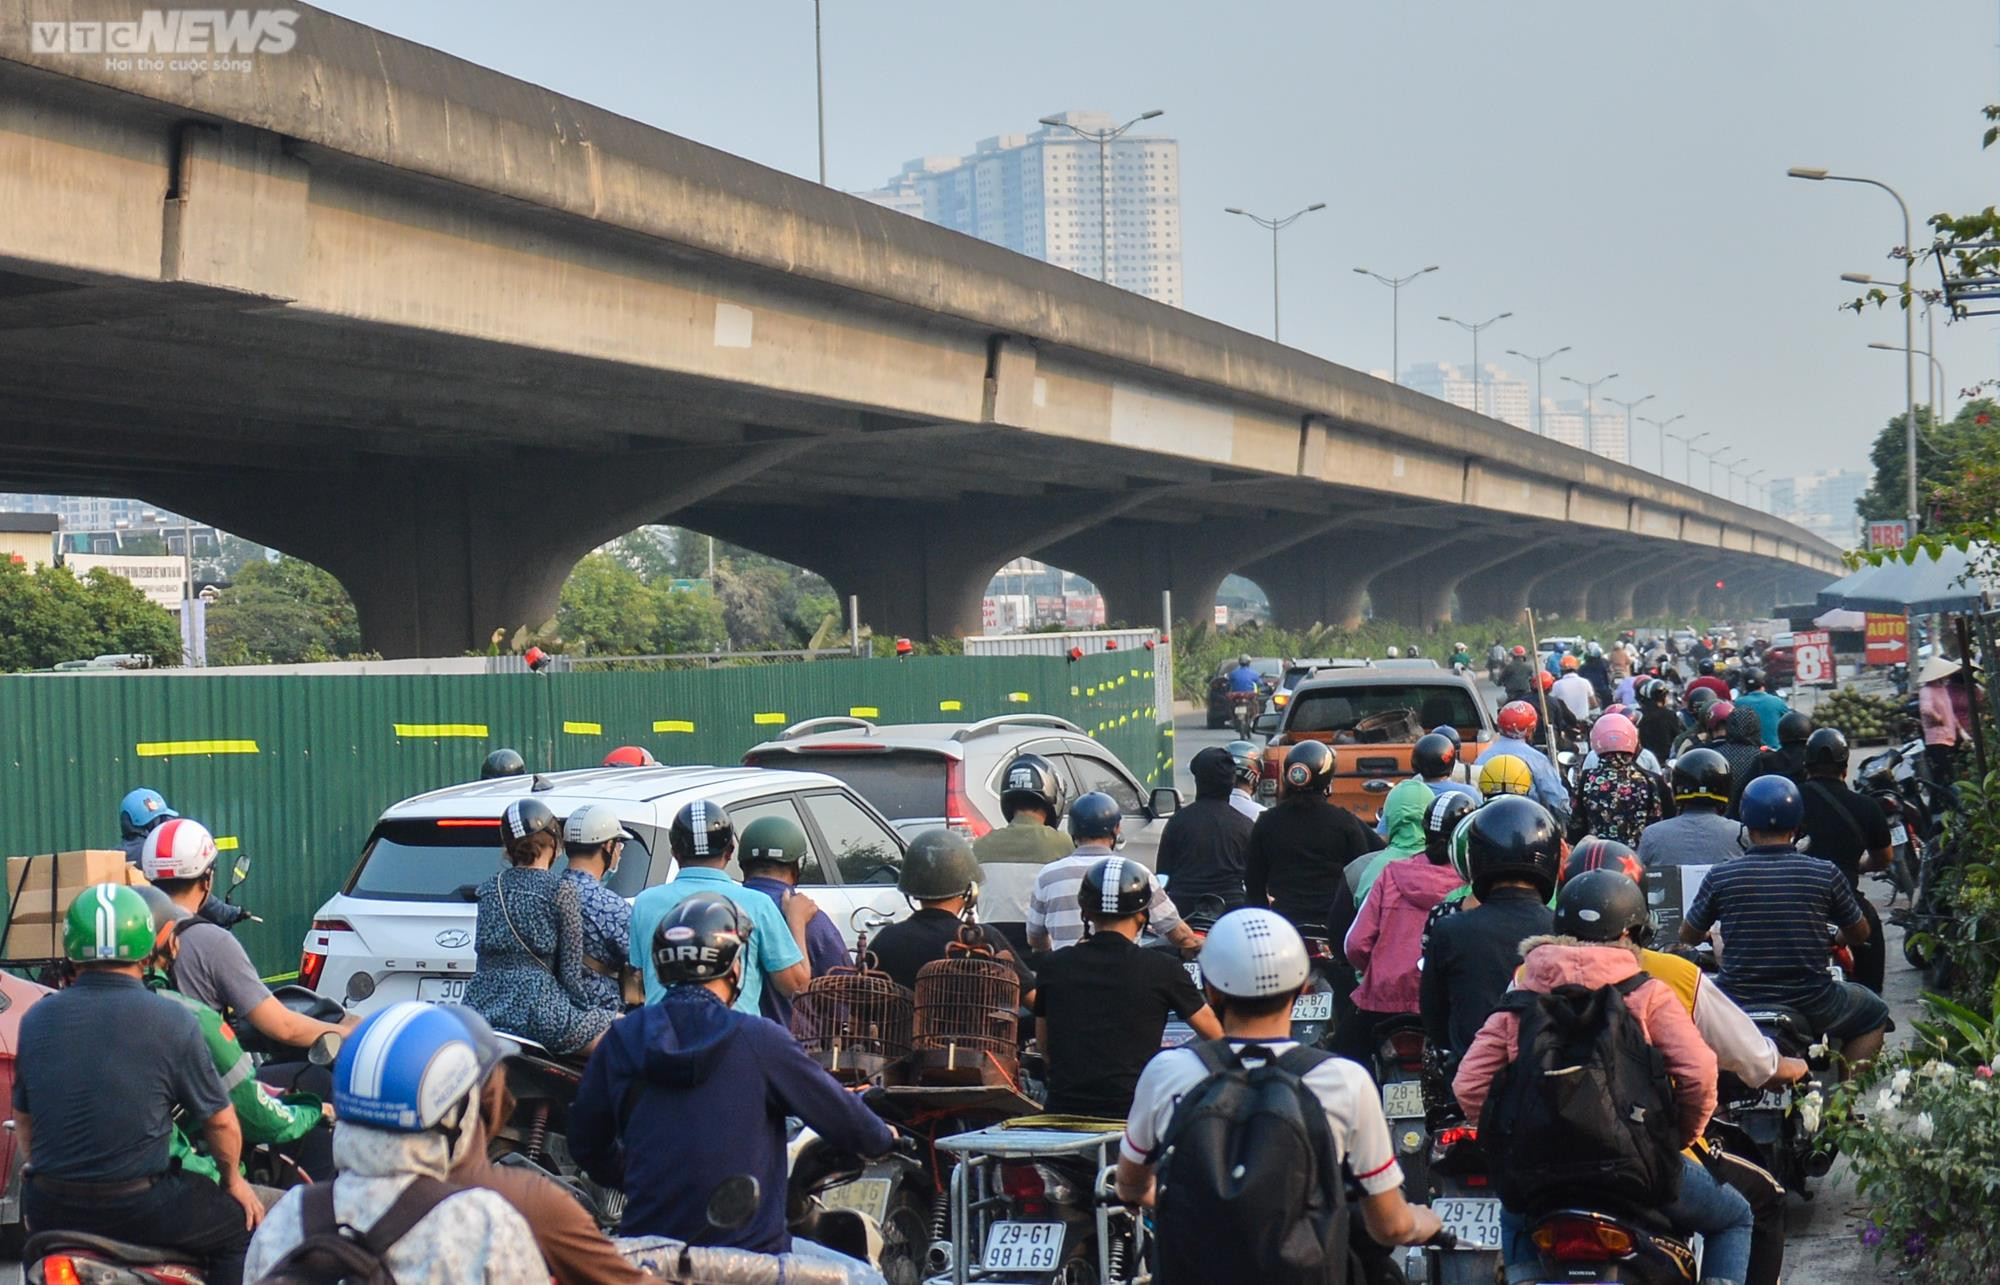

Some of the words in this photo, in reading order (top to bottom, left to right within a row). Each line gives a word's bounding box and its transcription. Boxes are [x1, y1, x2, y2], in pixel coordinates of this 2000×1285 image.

[1867, 622, 1905, 636] AUTO
[655, 946, 720, 965] ORE
[385, 960, 457, 969] CRE
[440, 981, 463, 998] 30
[1296, 994, 1324, 1006] 6-B7
[1293, 1006, 1328, 1018] 24.79
[1443, 1203, 1495, 1223] 29-Z1
[999, 1225, 1051, 1245] 29-G1
[989, 1247, 1054, 1267] 981.69
